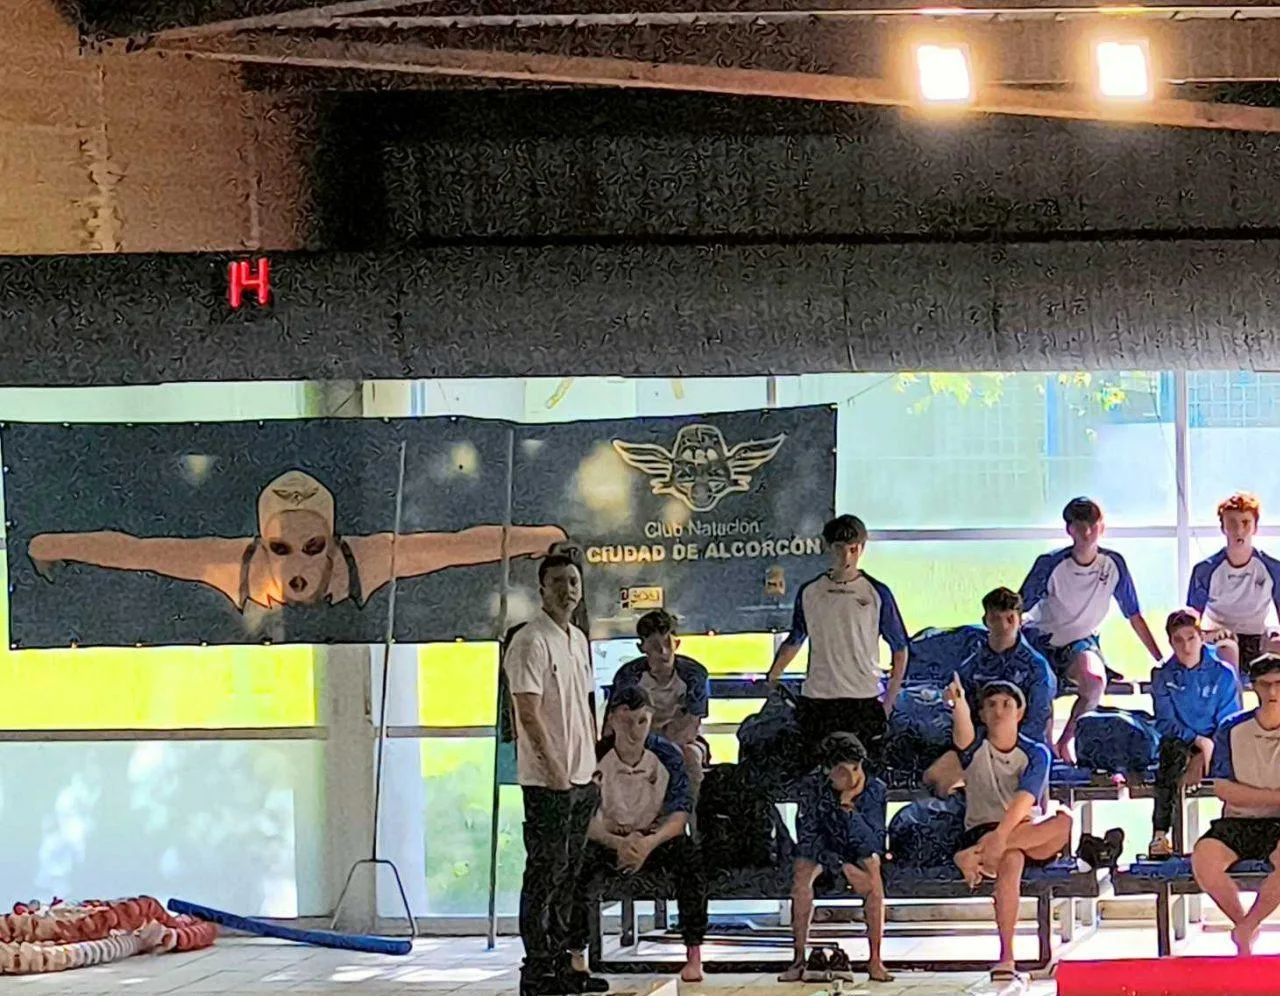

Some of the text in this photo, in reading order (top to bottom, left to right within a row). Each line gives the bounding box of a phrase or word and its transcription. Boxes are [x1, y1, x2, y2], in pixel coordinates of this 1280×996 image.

[644, 520, 684, 539] Club
[586, 535, 822, 563] CIUDAD DE ALCORCÓN
